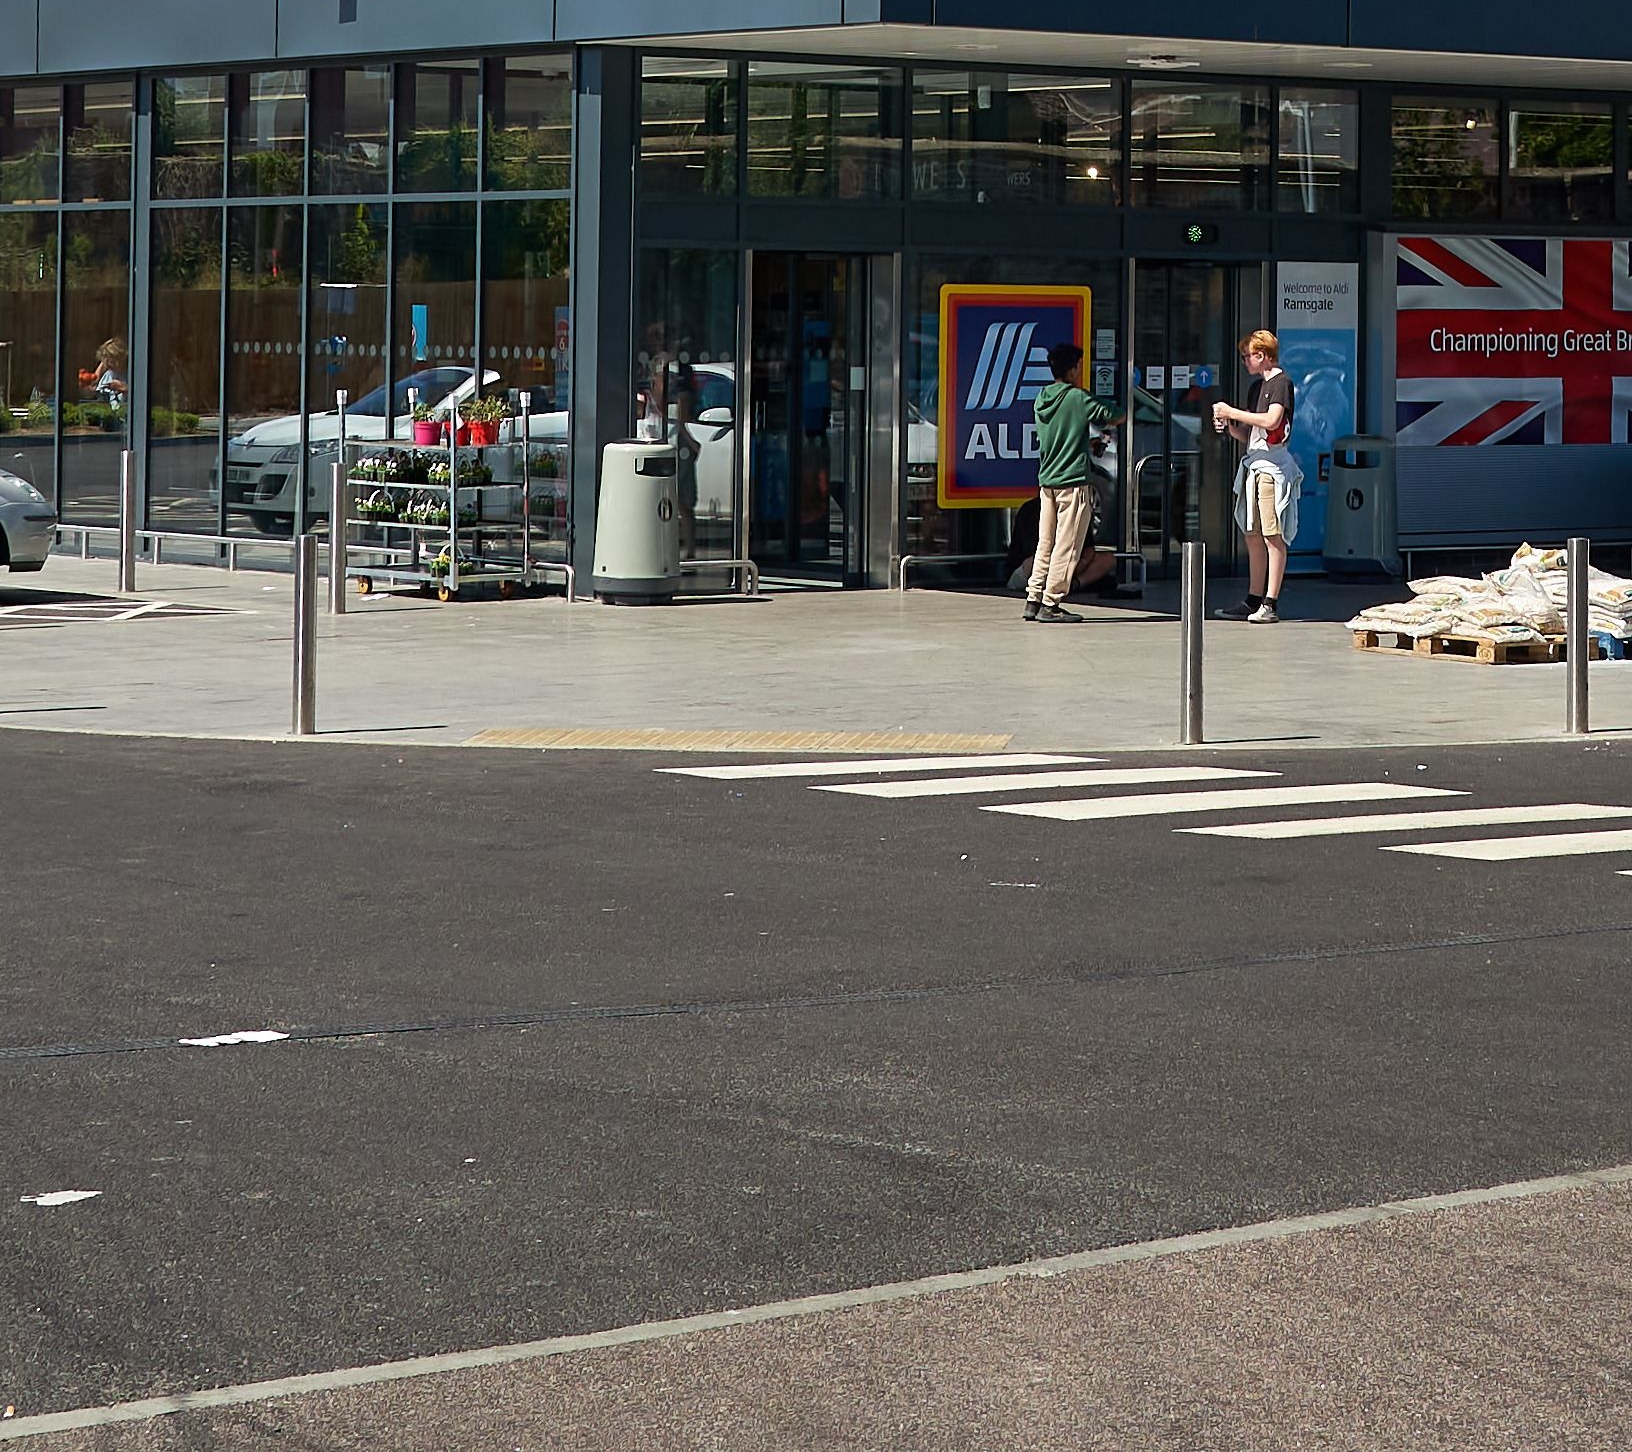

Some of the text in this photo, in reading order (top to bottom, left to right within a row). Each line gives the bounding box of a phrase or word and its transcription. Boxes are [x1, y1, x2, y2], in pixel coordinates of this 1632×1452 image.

[1284, 283, 1350, 295] Welcome to Aldi
[1283, 298, 1334, 314] Ramsgate
[1429, 327, 1559, 358] Championing
[1563, 328, 1612, 352] Great
[964, 423, 1041, 460] ALD
